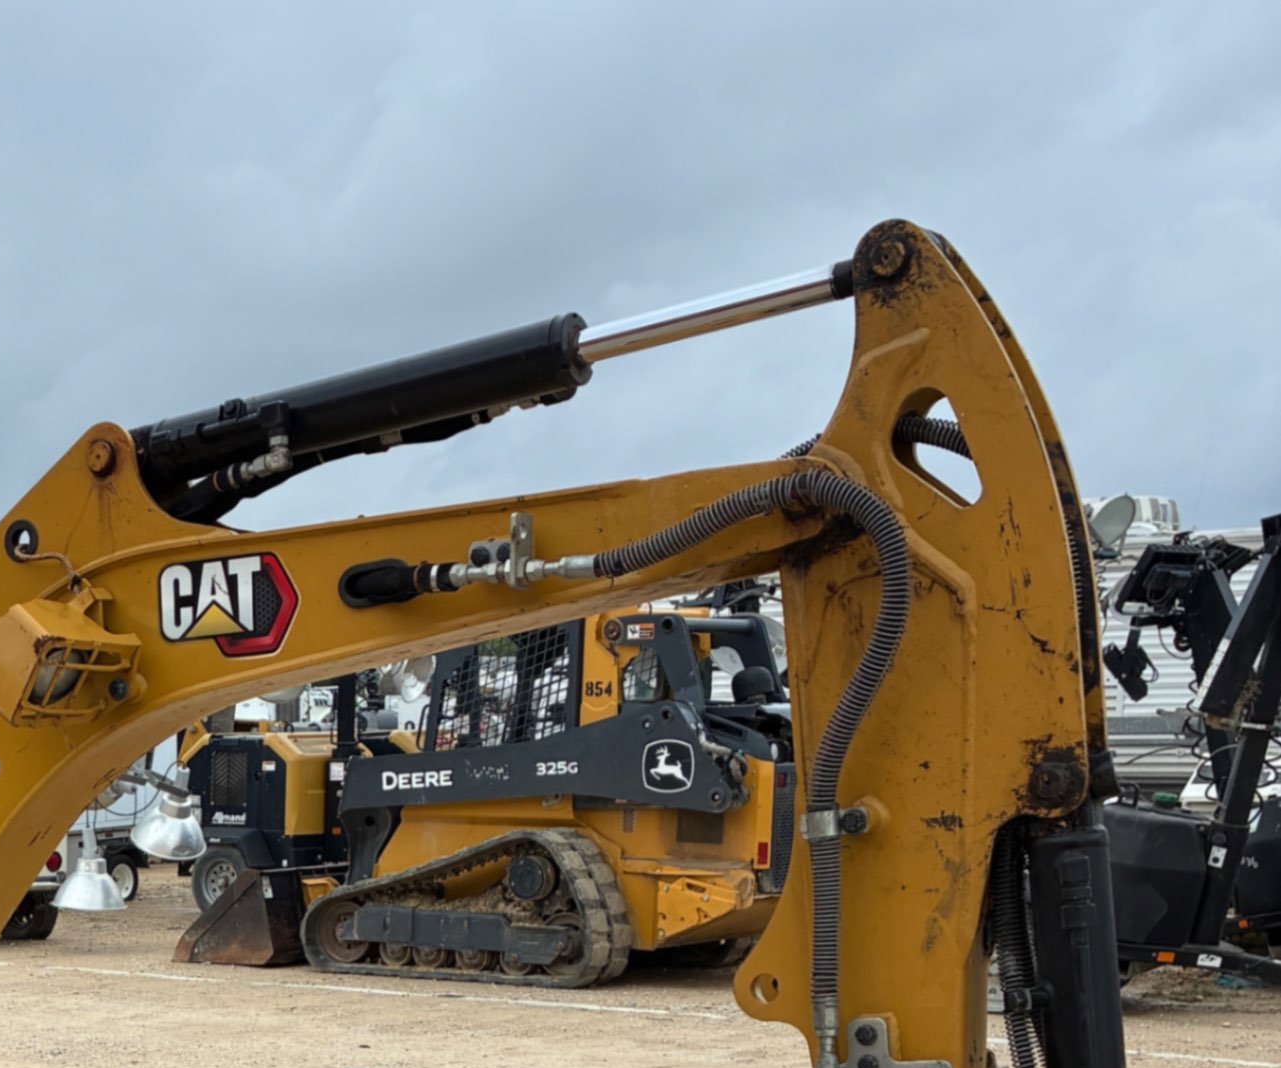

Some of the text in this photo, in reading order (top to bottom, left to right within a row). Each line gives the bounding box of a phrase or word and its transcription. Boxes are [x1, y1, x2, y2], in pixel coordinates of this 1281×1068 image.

[160, 555, 261, 640] CAT
[585, 682, 613, 697] 854
[381, 762, 579, 791] DEERE 325G
